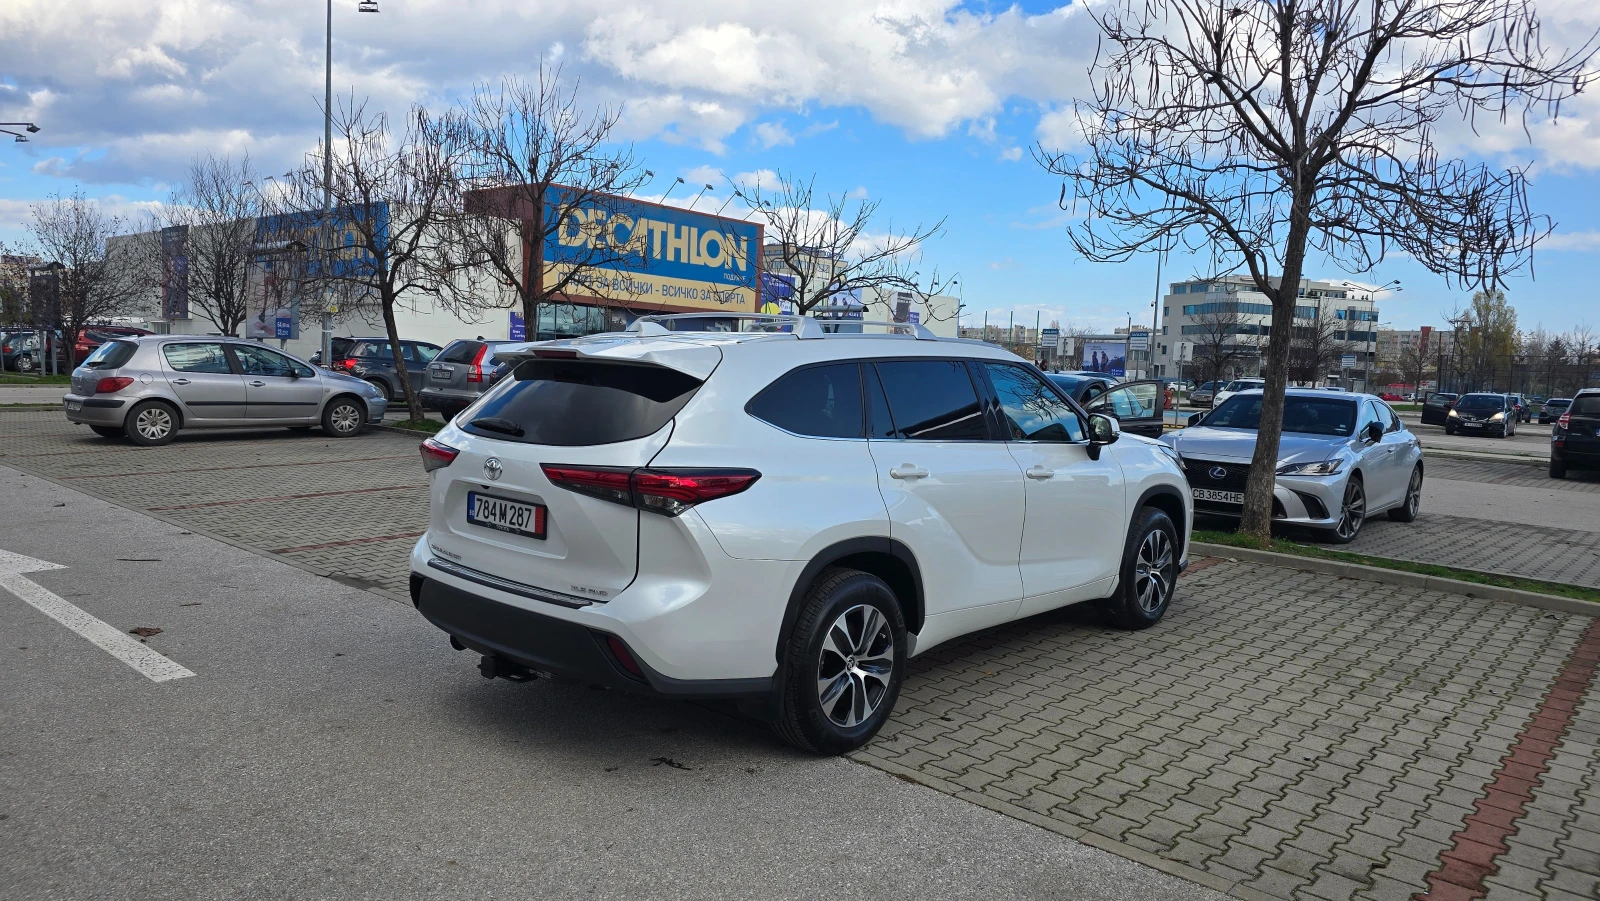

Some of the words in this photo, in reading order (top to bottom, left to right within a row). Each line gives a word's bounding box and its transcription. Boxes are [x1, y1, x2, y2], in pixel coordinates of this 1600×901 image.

[557, 203, 747, 271] DECATHLON
[612, 279, 653, 294] ВСИЧКИ
[661, 284, 698, 299] ВСИЧКО
[700, 289, 713, 300] ЗА
[1206, 491, 1229, 501] 3854
[476, 498, 497, 521] 784
[499, 503, 507, 523] M
[509, 505, 532, 528] 287
